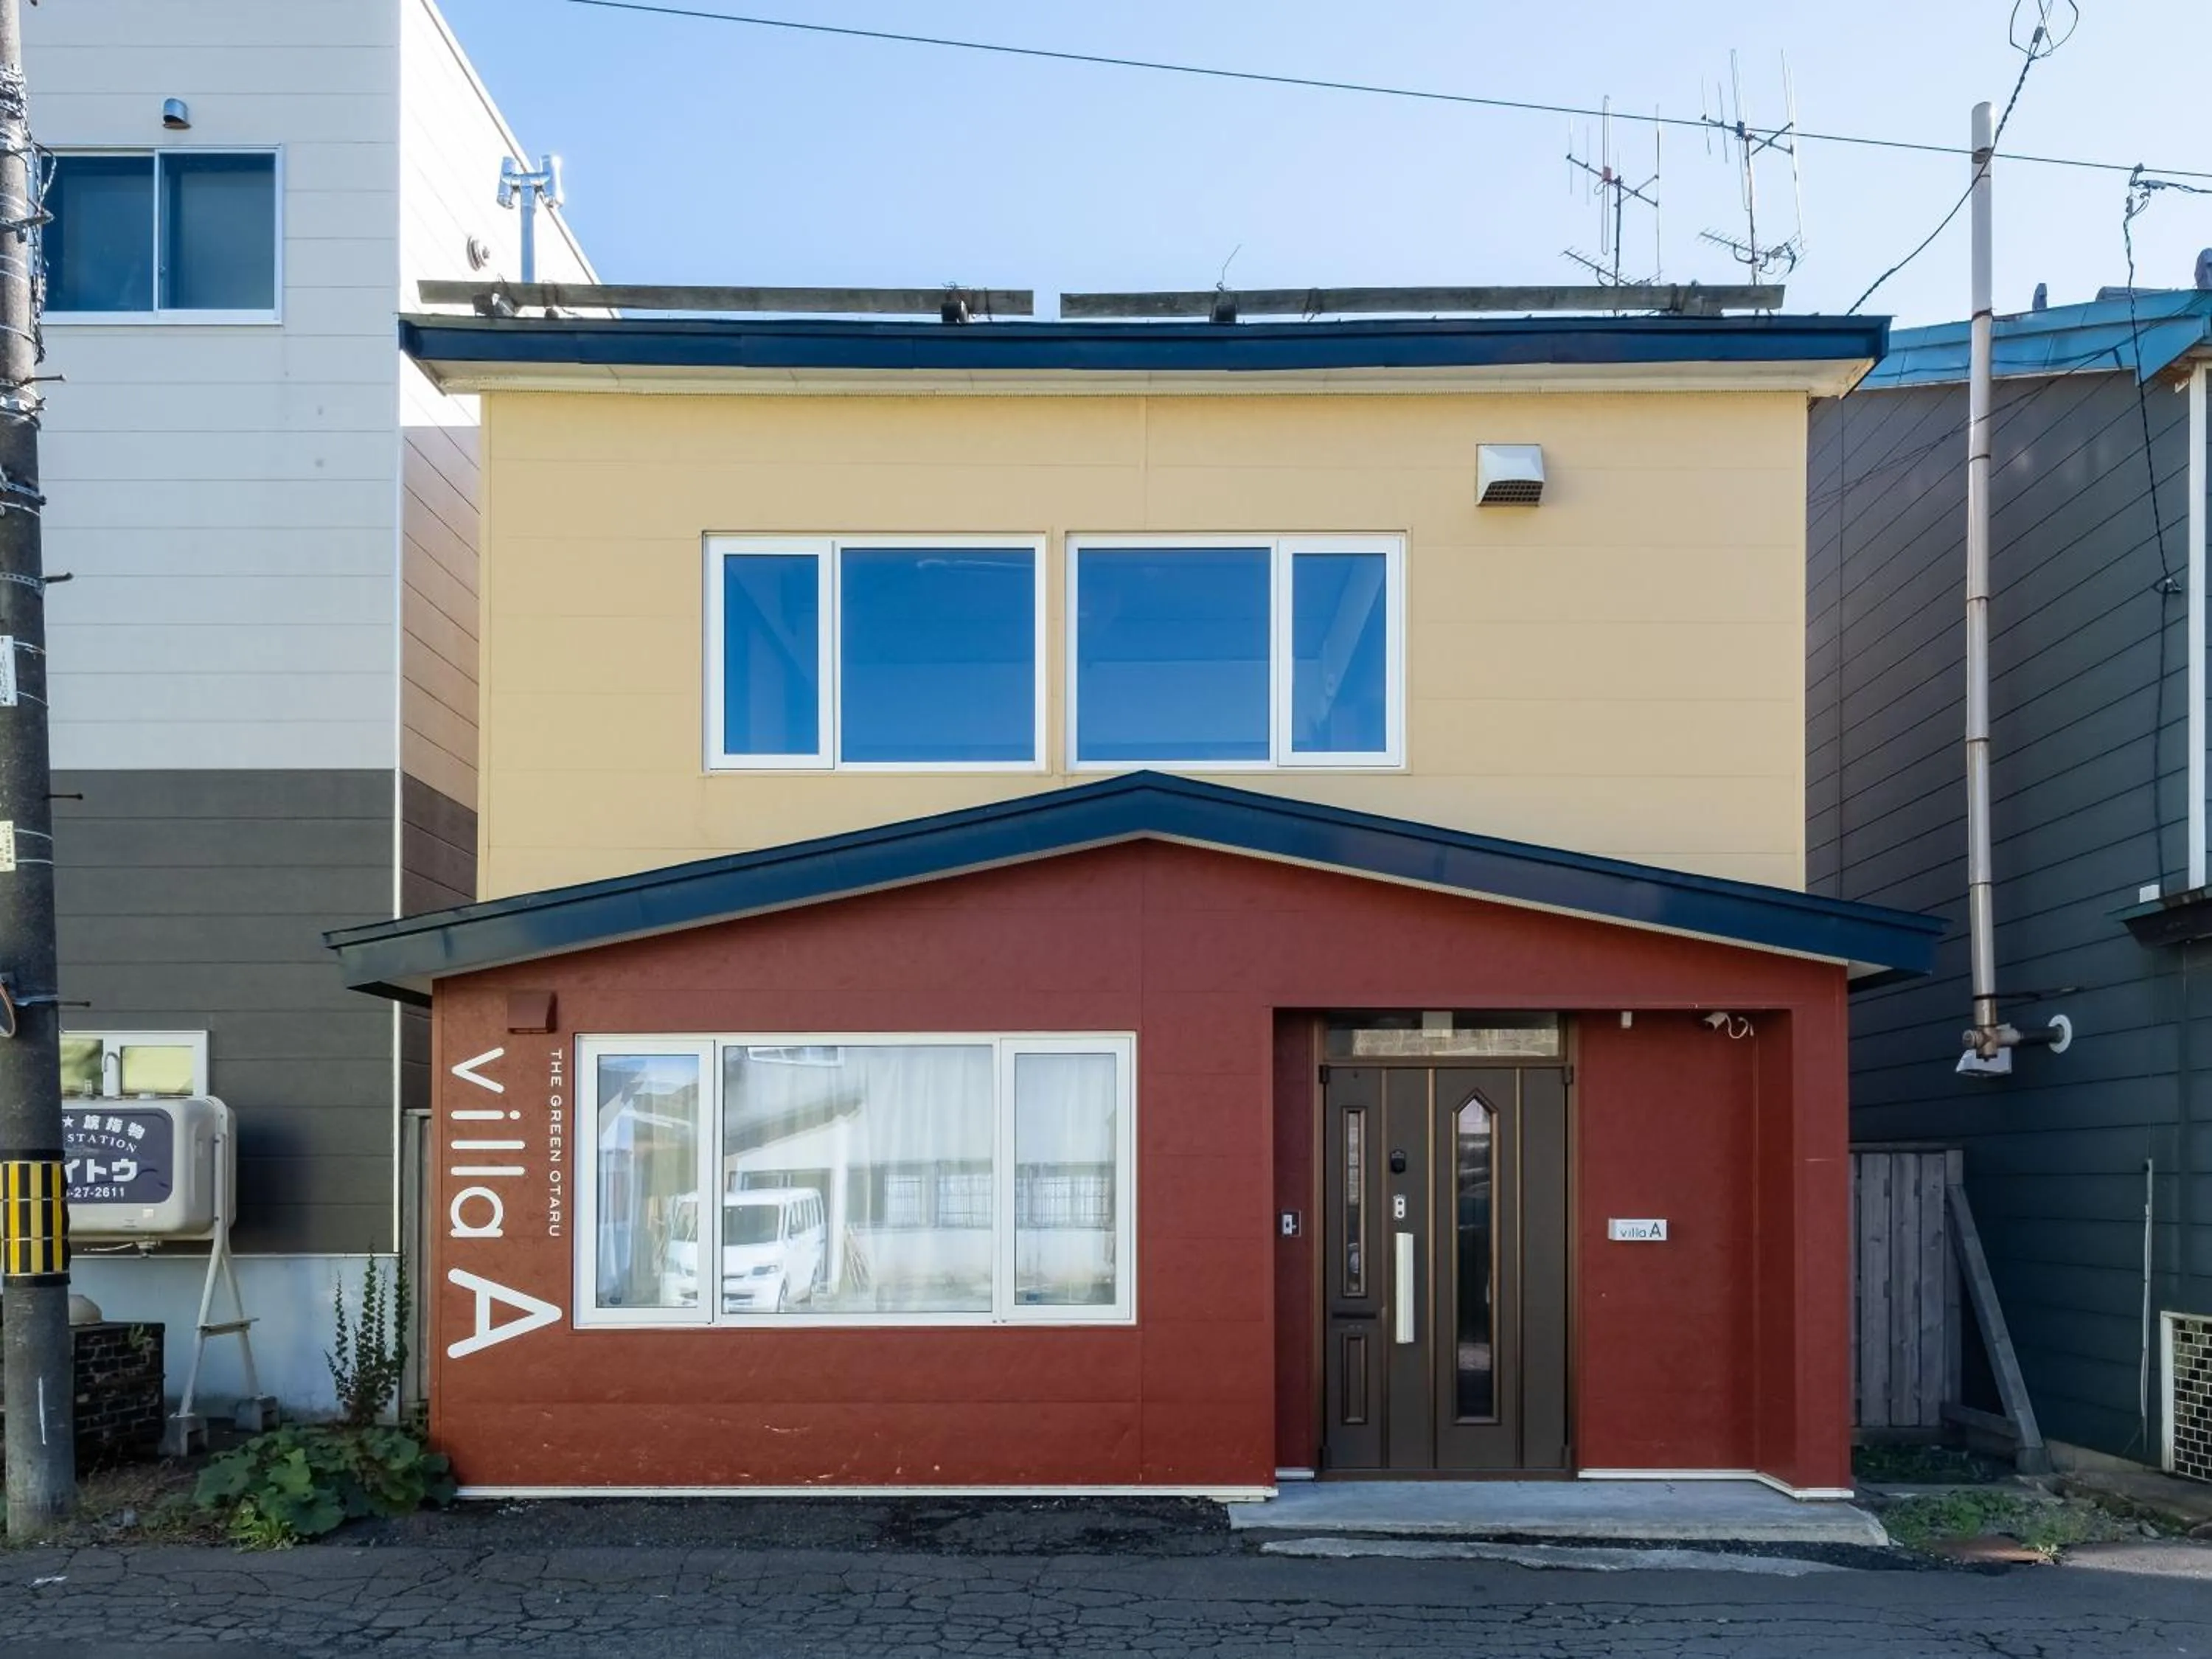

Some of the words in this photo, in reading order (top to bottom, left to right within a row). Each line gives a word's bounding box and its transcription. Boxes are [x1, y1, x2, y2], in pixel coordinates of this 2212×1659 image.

[550, 1048, 563, 1087] THE
[67, 1133, 137, 1152] STATION
[451, 1048, 525, 1237] villa
[549, 1095, 563, 1162] GREEN
[66, 1186, 125, 1198] -27-2611
[549, 1170, 562, 1237] OTARU
[1620, 1227, 1646, 1238] villa
[1649, 1222, 1662, 1238] A
[448, 1268, 562, 1358] A
